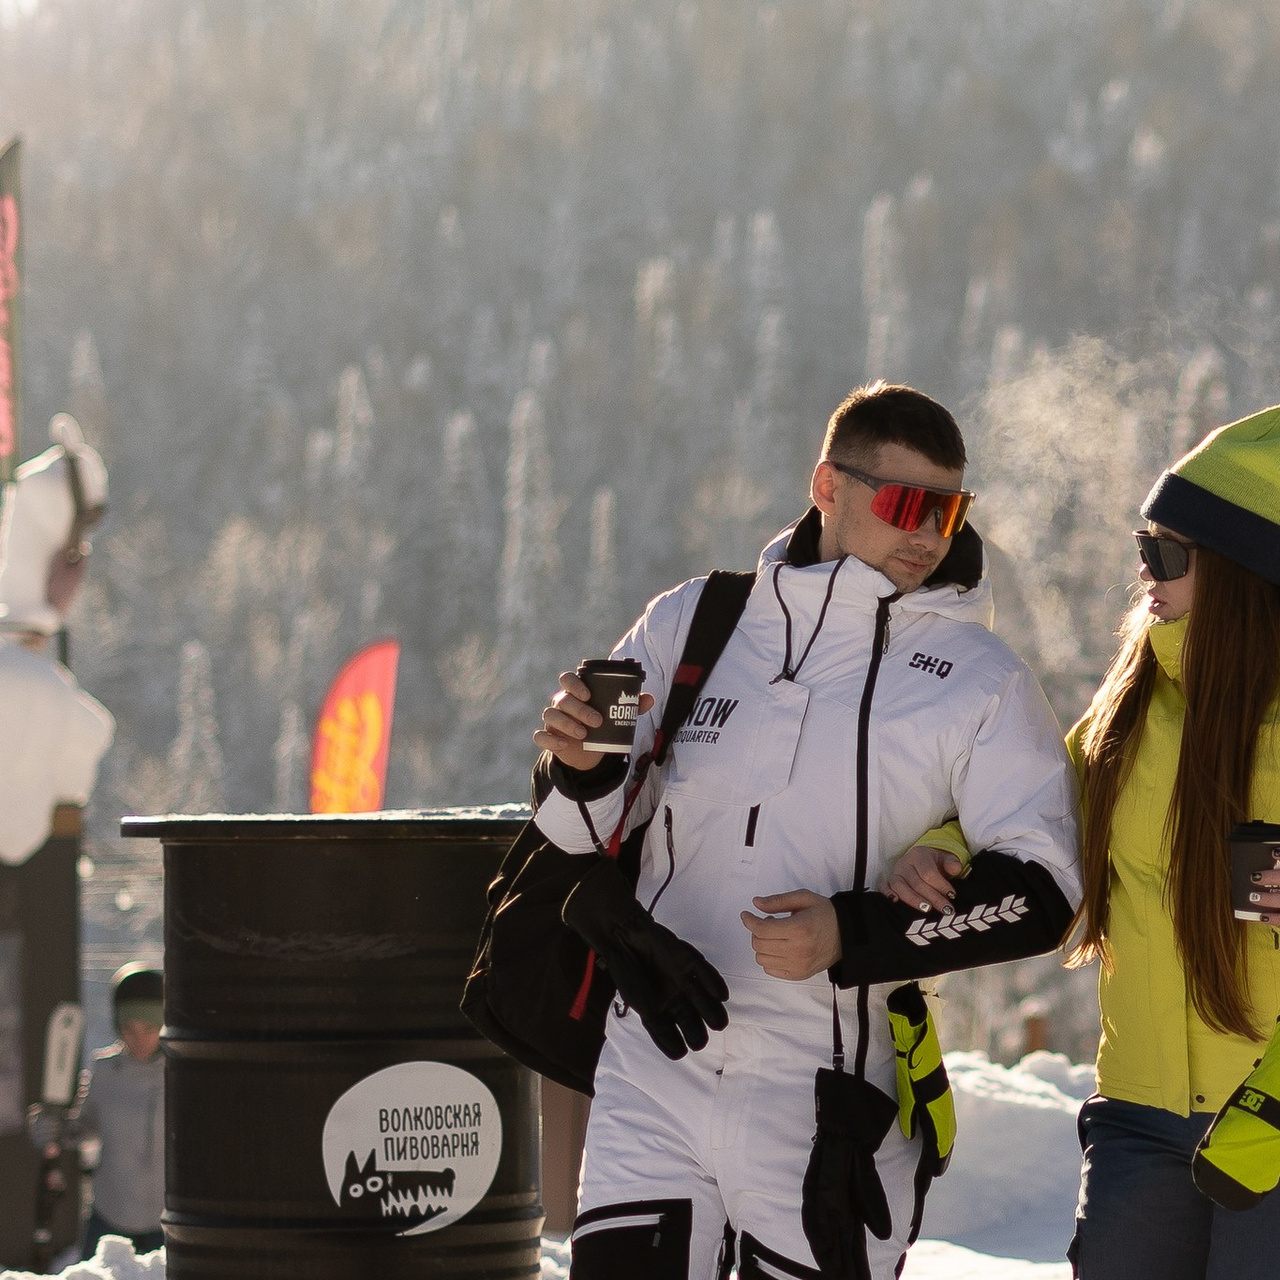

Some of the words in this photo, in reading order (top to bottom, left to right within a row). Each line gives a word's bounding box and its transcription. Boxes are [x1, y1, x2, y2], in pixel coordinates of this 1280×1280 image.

[681, 697, 740, 729] NOW
[379, 1102, 482, 1133] ВОЛКОВСКАЯ
[384, 1131, 479, 1161] ПИВОВАРНЯ
